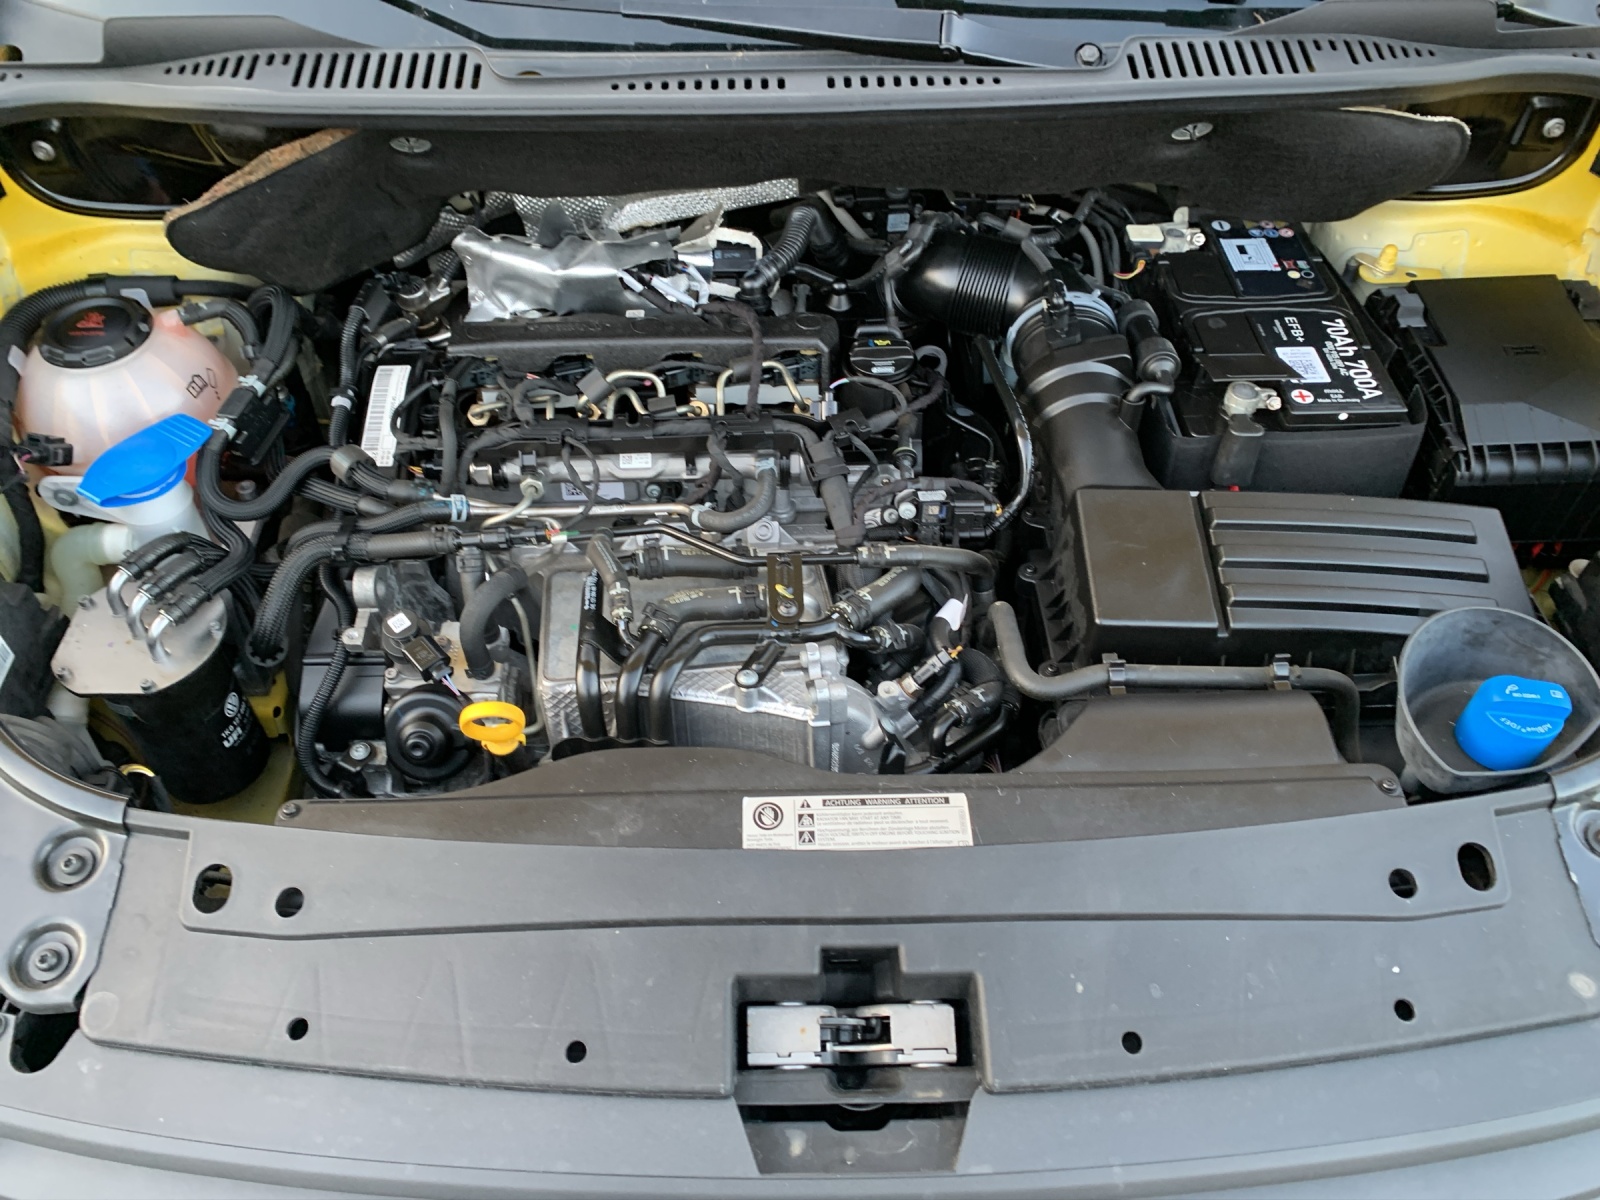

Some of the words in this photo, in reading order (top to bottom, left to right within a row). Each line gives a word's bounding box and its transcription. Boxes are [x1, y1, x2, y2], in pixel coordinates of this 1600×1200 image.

[1283, 316, 1305, 343] EFB+
[1321, 318, 1359, 357] 70Ah
[1344, 359, 1383, 400] 700A
[865, 798, 901, 806] WARNING
[904, 797, 945, 805] ATTENTION
